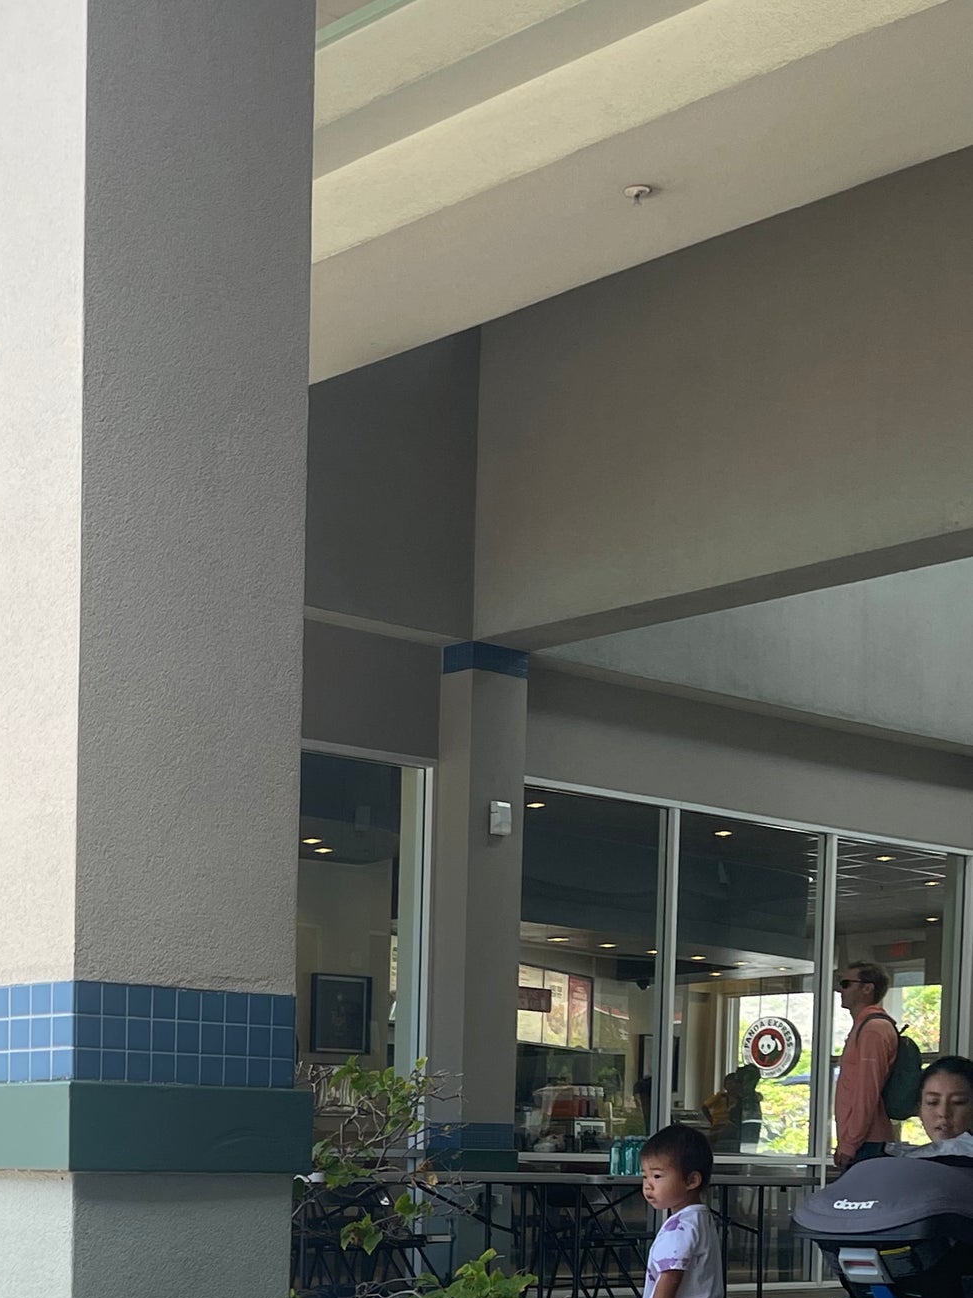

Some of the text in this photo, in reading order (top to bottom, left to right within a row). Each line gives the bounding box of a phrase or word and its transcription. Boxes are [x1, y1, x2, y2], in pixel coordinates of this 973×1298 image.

[744, 1019, 794, 1049] PANDA EXPRESS
[833, 1198, 875, 1210] doona
